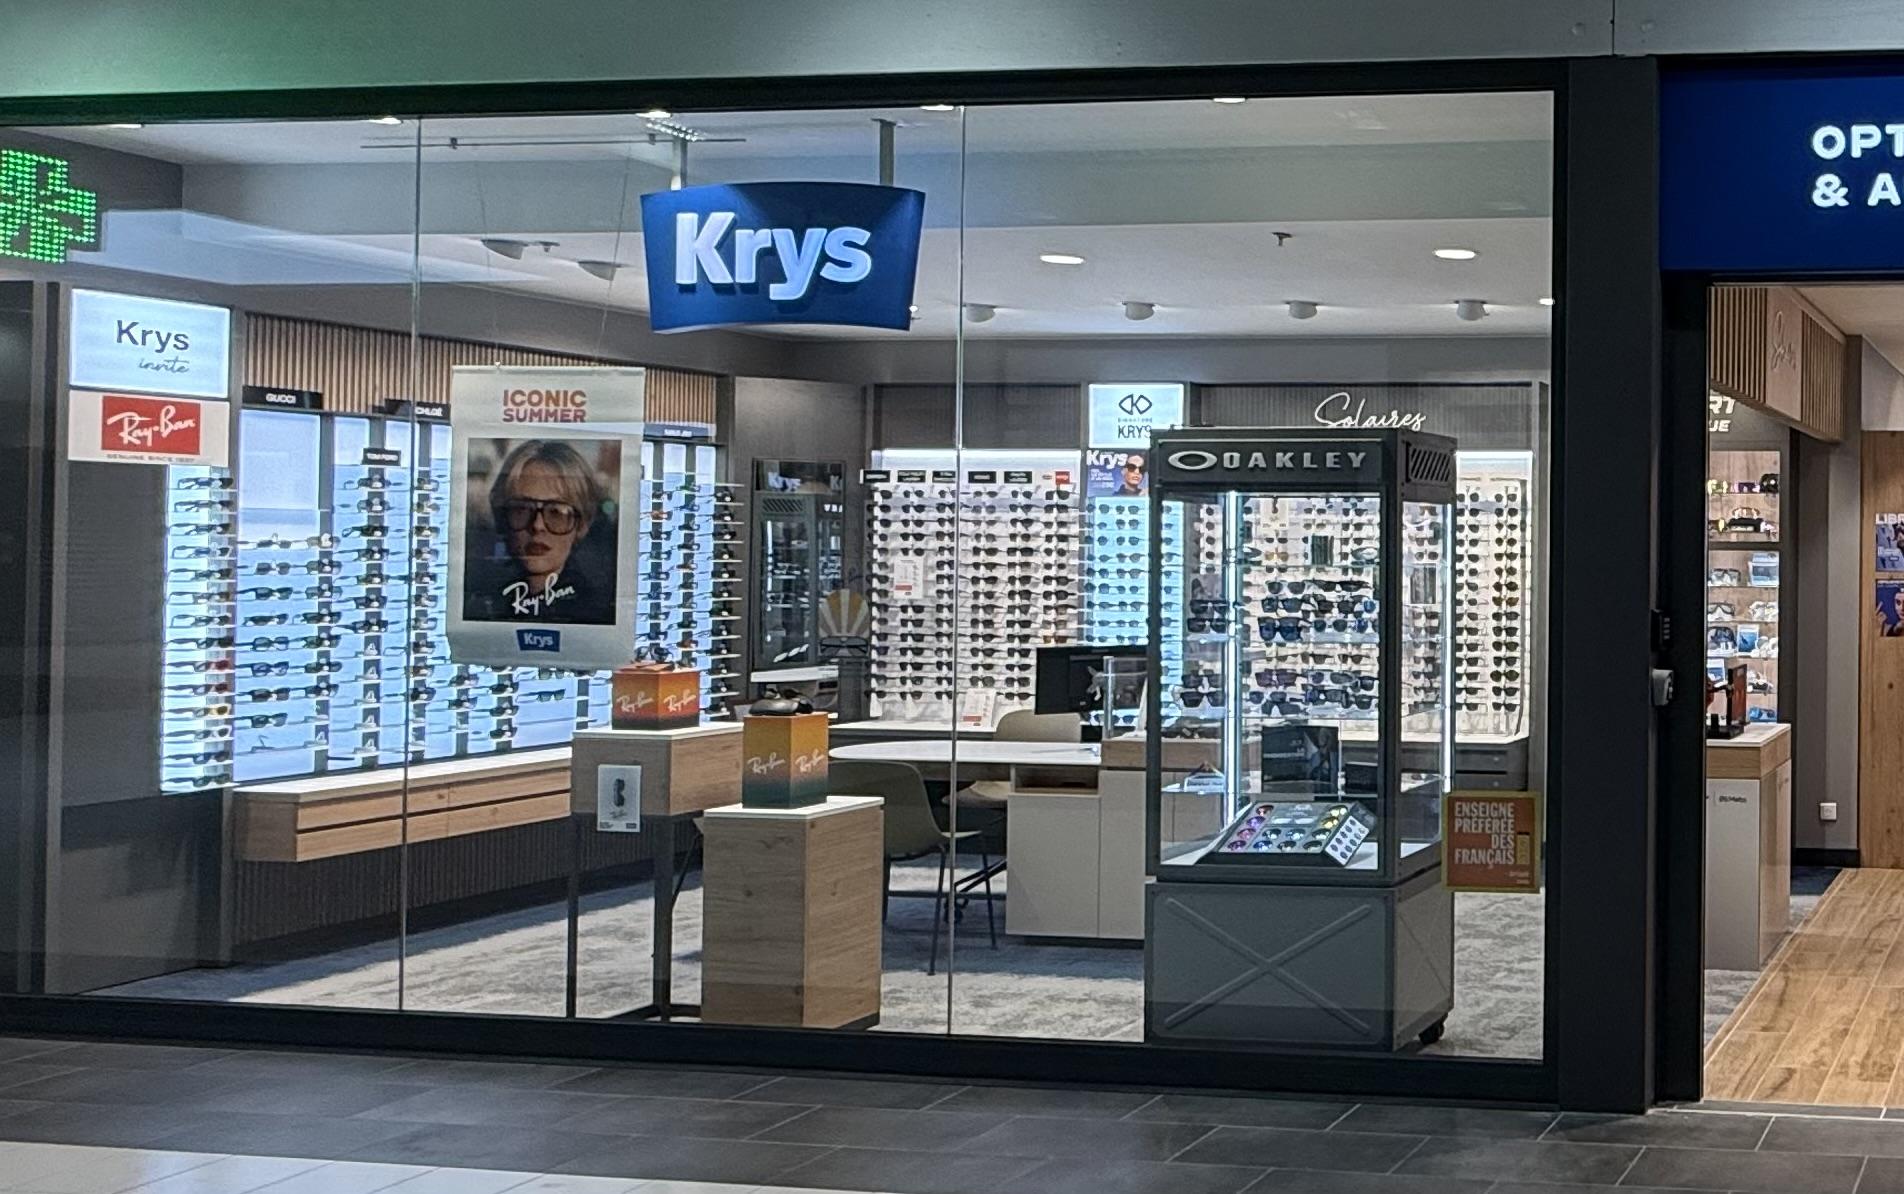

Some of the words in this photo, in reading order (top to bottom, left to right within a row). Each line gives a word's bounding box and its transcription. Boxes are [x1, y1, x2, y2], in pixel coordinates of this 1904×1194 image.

[1812, 173, 1849, 208] &
[674, 211, 872, 302] Krys
[116, 319, 190, 354] Krys
[138, 355, 191, 374] invite
[265, 393, 297, 404] GUCCI
[502, 389, 587, 408] ICONIC
[502, 407, 587, 424] SUMMER
[1314, 391, 1427, 432] Solaires
[1117, 424, 1153, 440] KRYS
[1086, 449, 1129, 469] Krys
[1222, 451, 1367, 470] OAKLEY
[523, 632, 554, 648] Krys
[1454, 801, 1515, 818] ENSEIGNE
[1490, 833, 1515, 849] DES
[1453, 848, 1515, 869] FRANÇAIS
